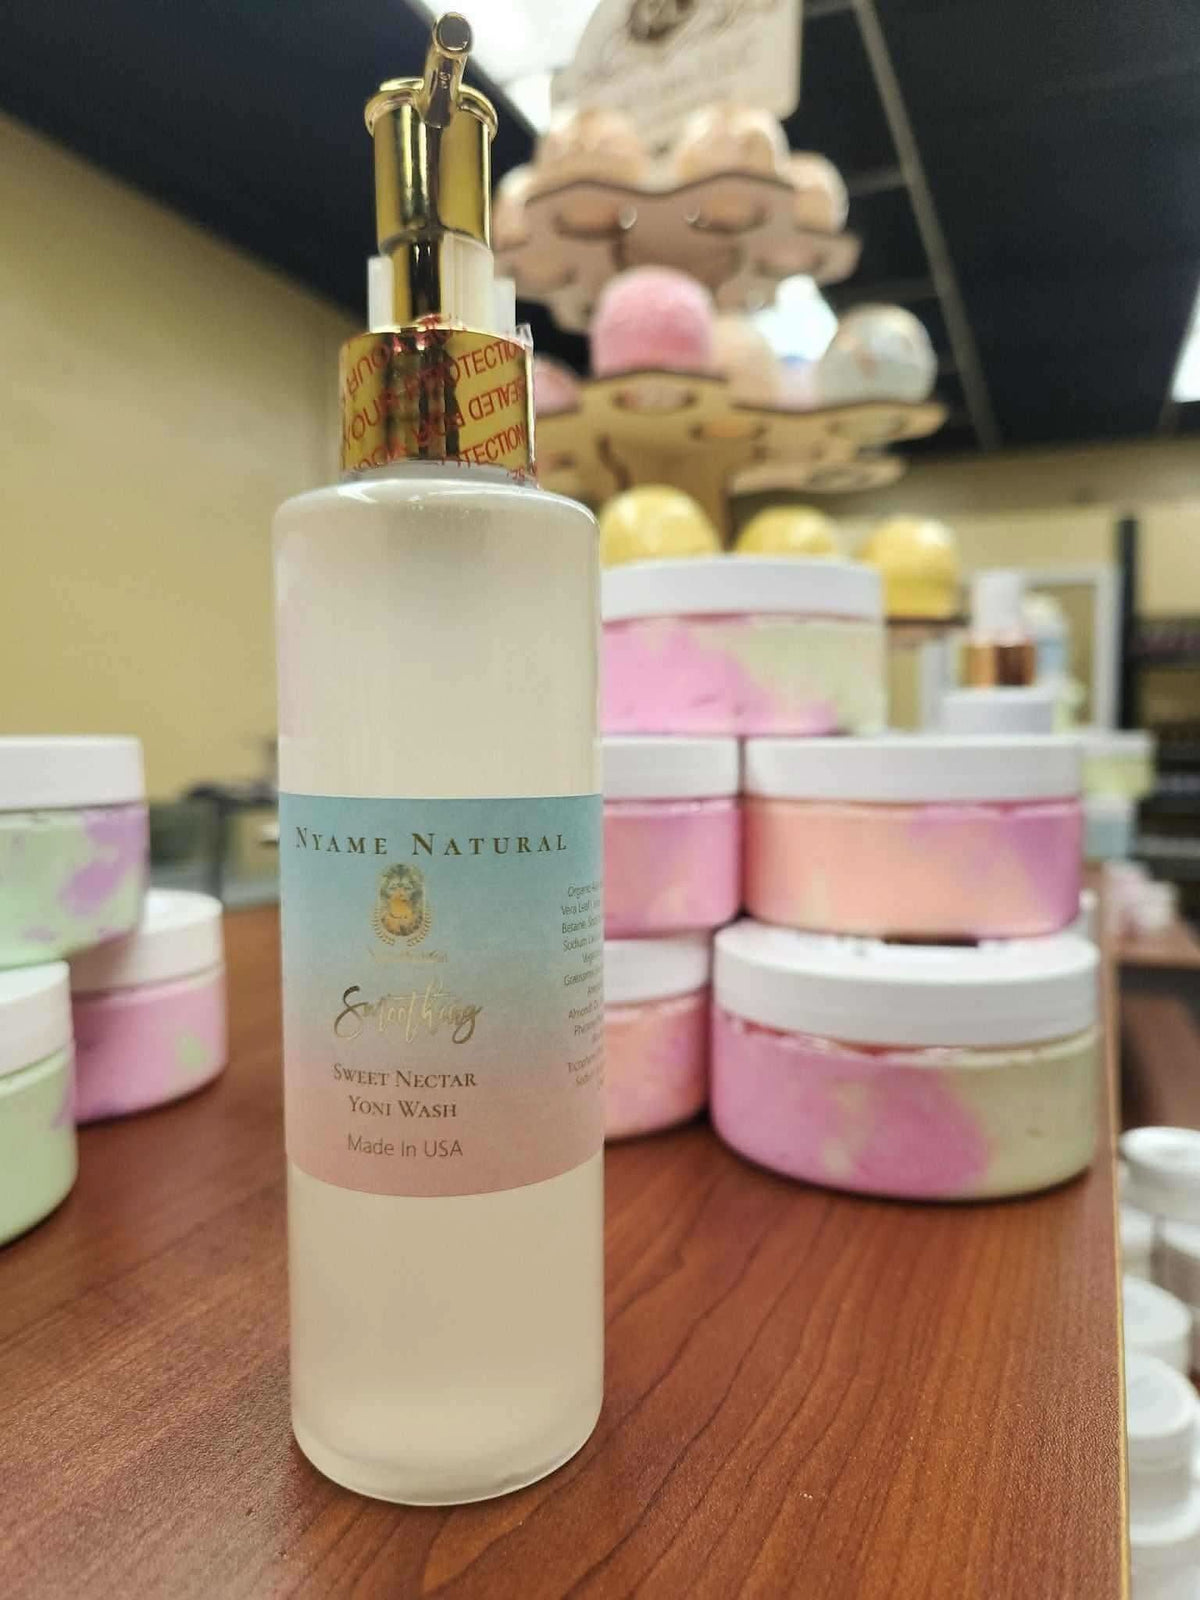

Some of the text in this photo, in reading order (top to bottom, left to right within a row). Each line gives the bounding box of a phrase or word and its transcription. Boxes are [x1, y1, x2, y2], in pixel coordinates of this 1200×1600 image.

[296, 826, 567, 856] NYAME NATURAL
[333, 1063, 477, 1089] SWEET NECTAR
[349, 1095, 457, 1118] YONI WASH
[347, 1134, 463, 1158] Made In USA
